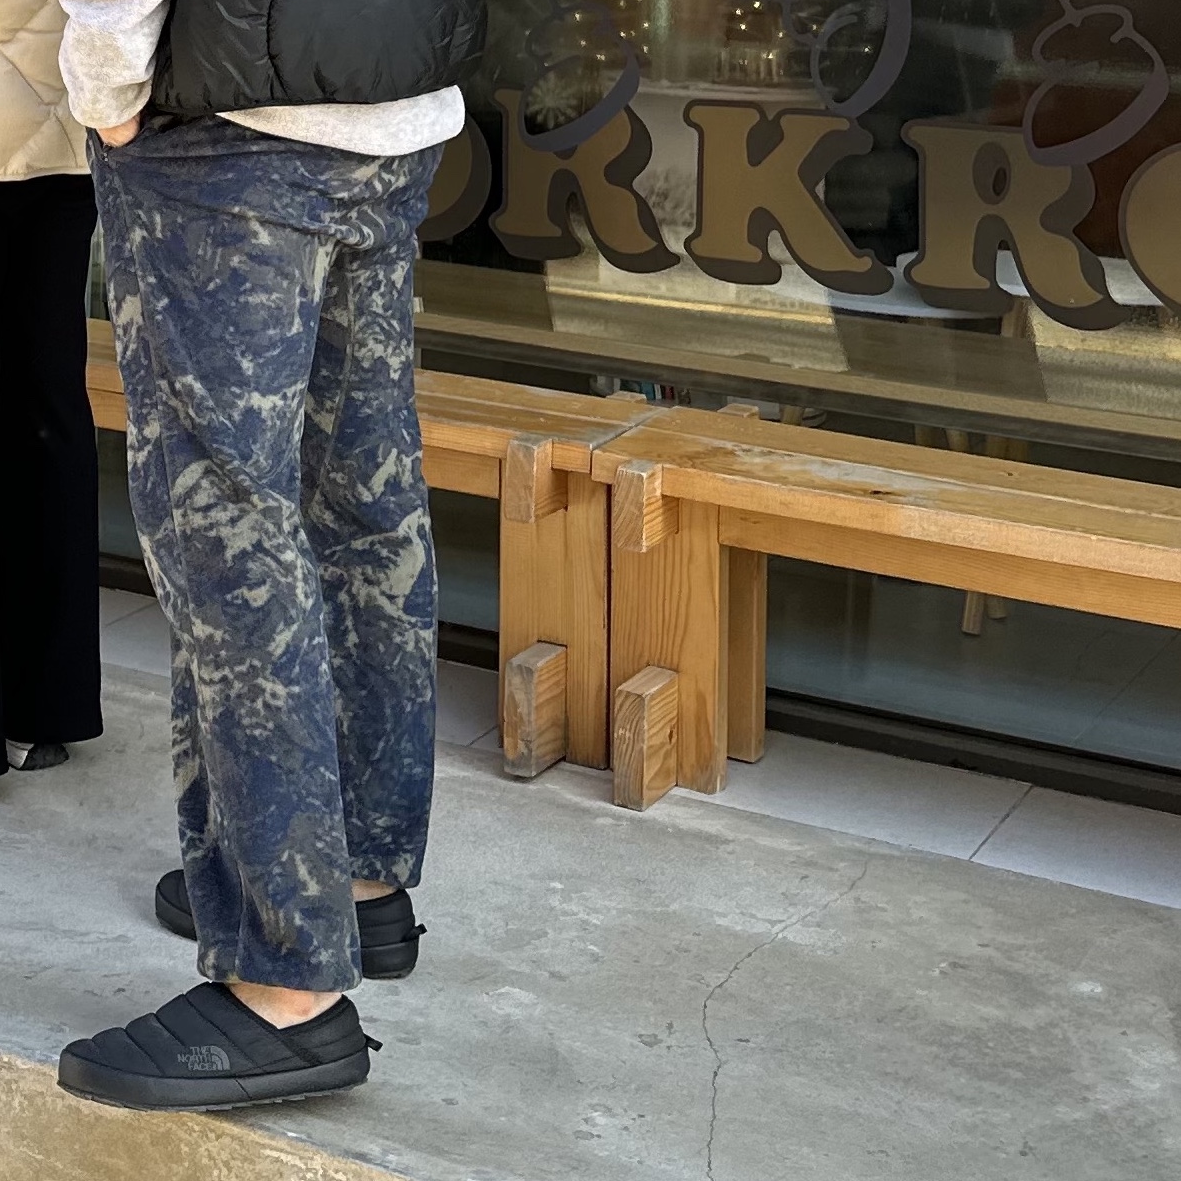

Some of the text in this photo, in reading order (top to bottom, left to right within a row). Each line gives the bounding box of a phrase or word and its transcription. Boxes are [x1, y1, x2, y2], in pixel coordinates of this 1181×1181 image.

[190, 1046, 211, 1054] THE
[177, 1054, 212, 1063] NORTH
[188, 1063, 212, 1071] FACE
